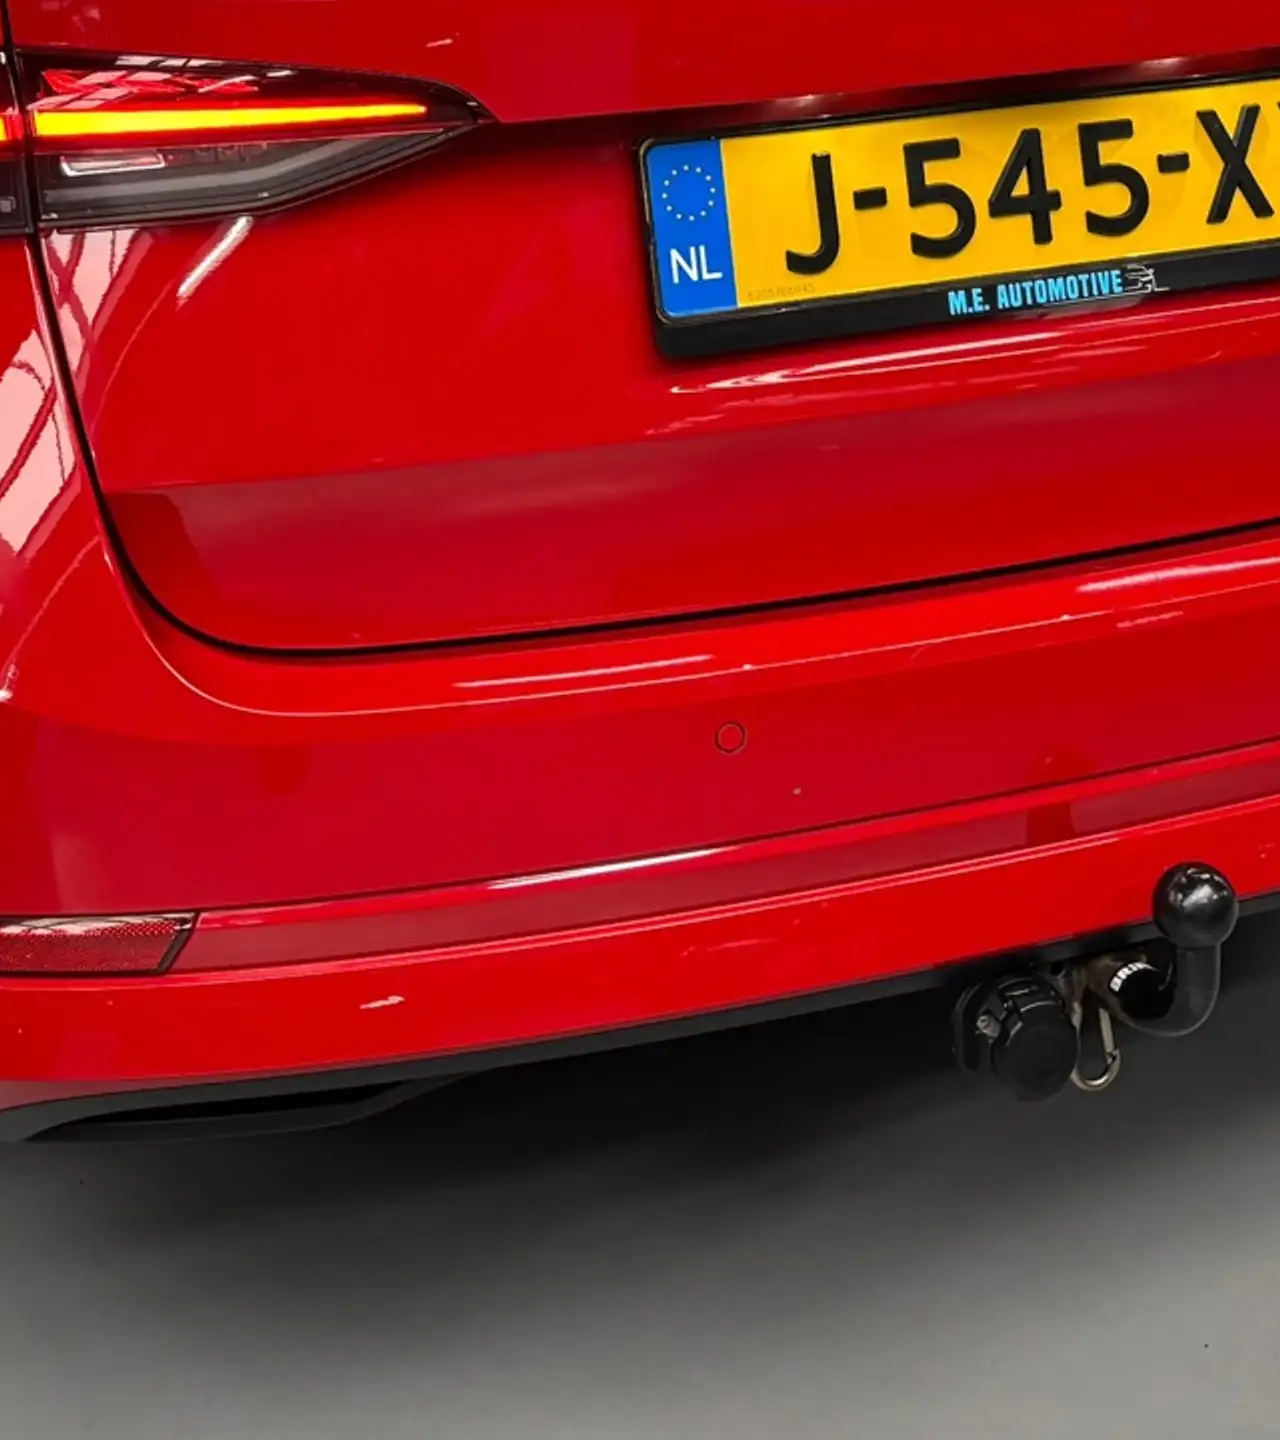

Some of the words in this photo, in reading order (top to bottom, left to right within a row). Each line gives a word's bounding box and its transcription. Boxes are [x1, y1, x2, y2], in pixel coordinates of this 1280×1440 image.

[669, 243, 724, 285] NL
[948, 287, 990, 316] M.E.
[996, 269, 1124, 309] AUTOMOTIVE
